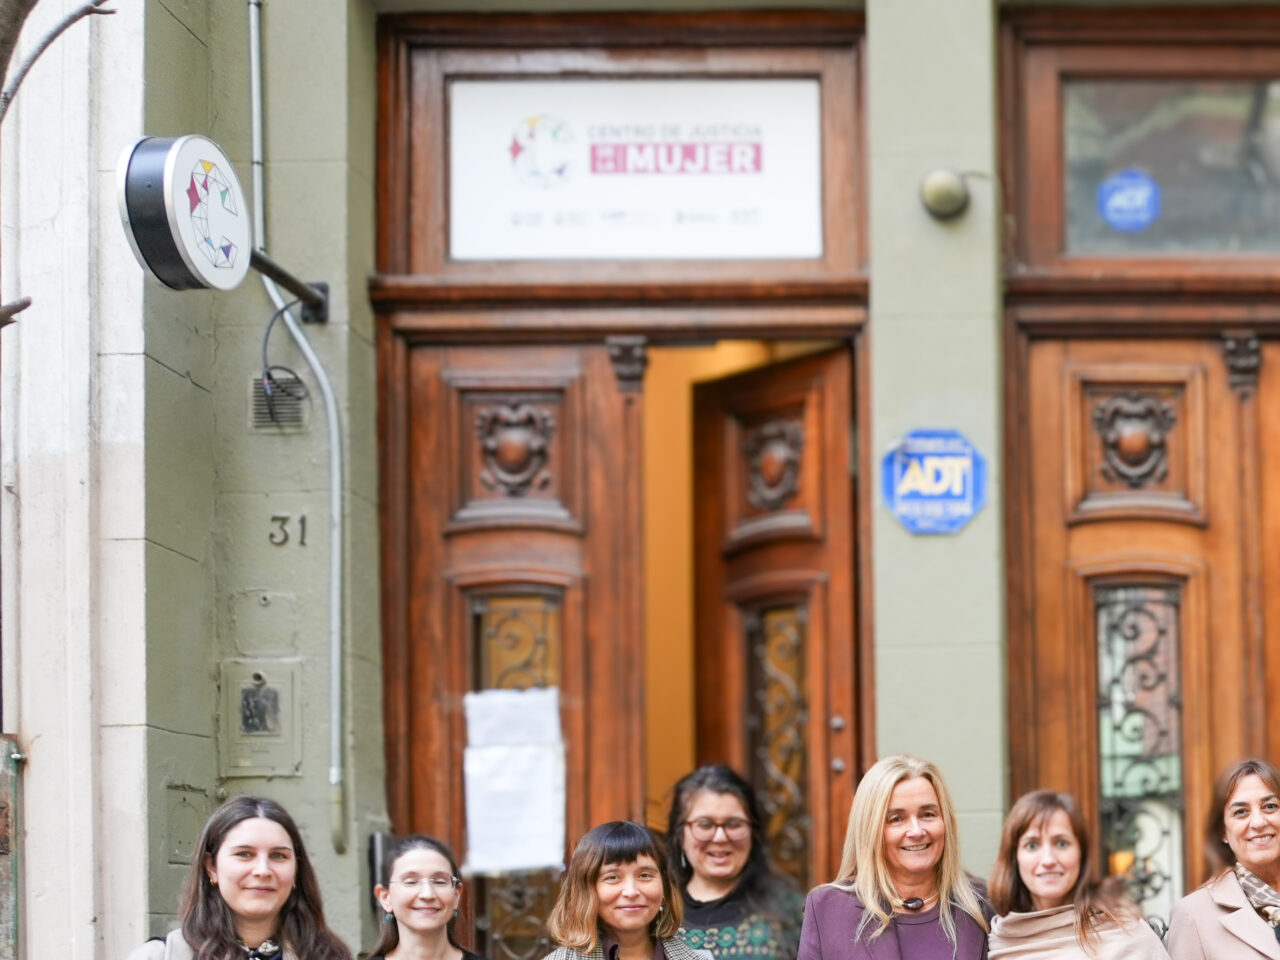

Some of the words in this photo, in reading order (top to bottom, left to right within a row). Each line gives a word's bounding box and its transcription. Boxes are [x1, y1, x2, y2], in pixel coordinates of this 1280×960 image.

[588, 124, 655, 138] CENTRO
[660, 124, 681, 138] DE
[689, 124, 763, 138] JUSTICIA
[626, 144, 756, 173] MUJER
[897, 456, 972, 496] ADT
[269, 515, 307, 547] 31
